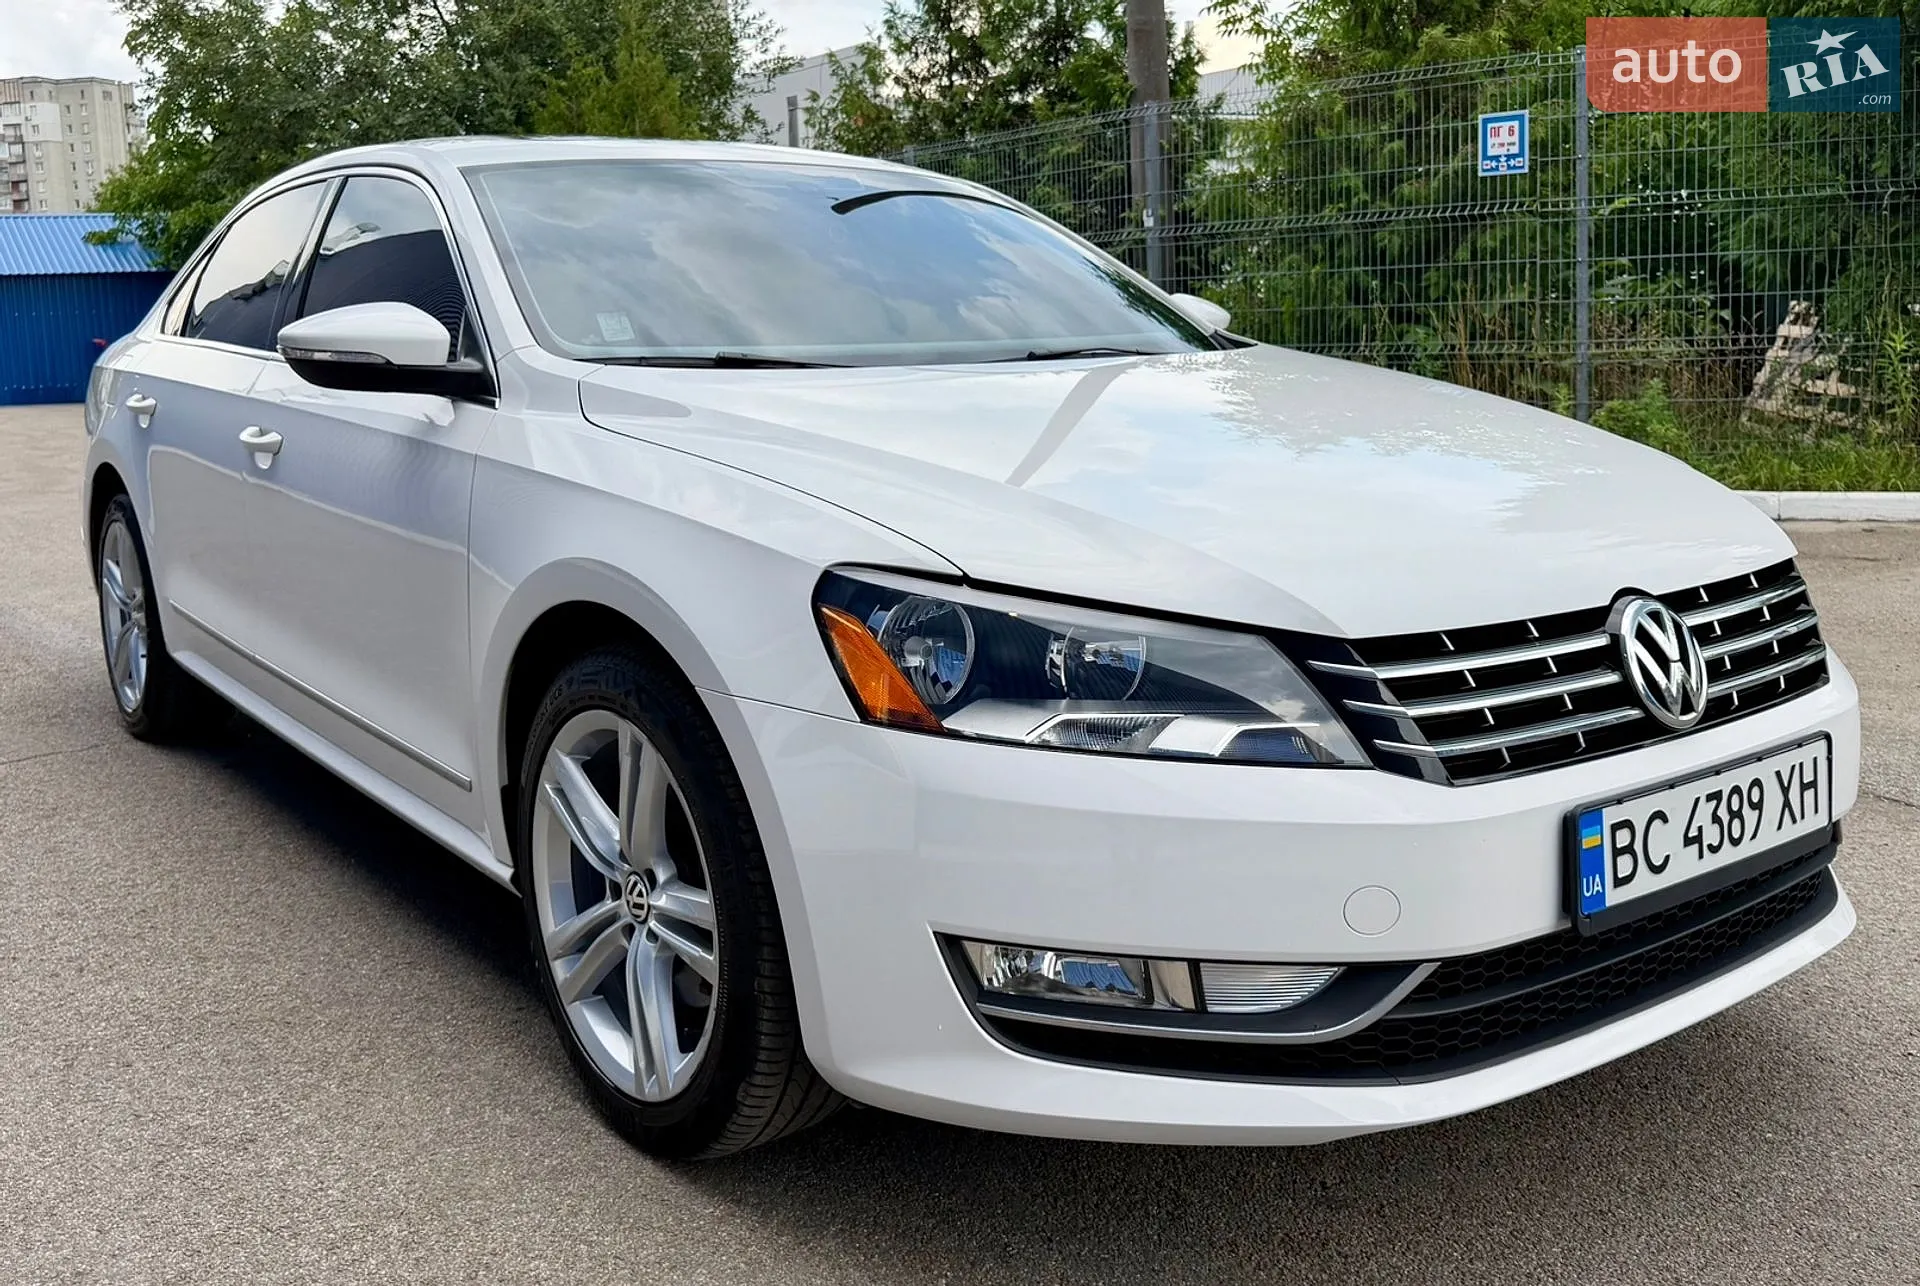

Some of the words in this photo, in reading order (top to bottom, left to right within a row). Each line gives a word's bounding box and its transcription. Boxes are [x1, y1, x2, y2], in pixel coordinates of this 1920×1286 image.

[1490, 125, 1503, 138] ПГ
[1508, 125, 1515, 137] 6
[1610, 809, 1671, 889] BC
[1683, 777, 1765, 861] 4389
[1774, 755, 1819, 831] XH
[1582, 875, 1603, 898] UA
